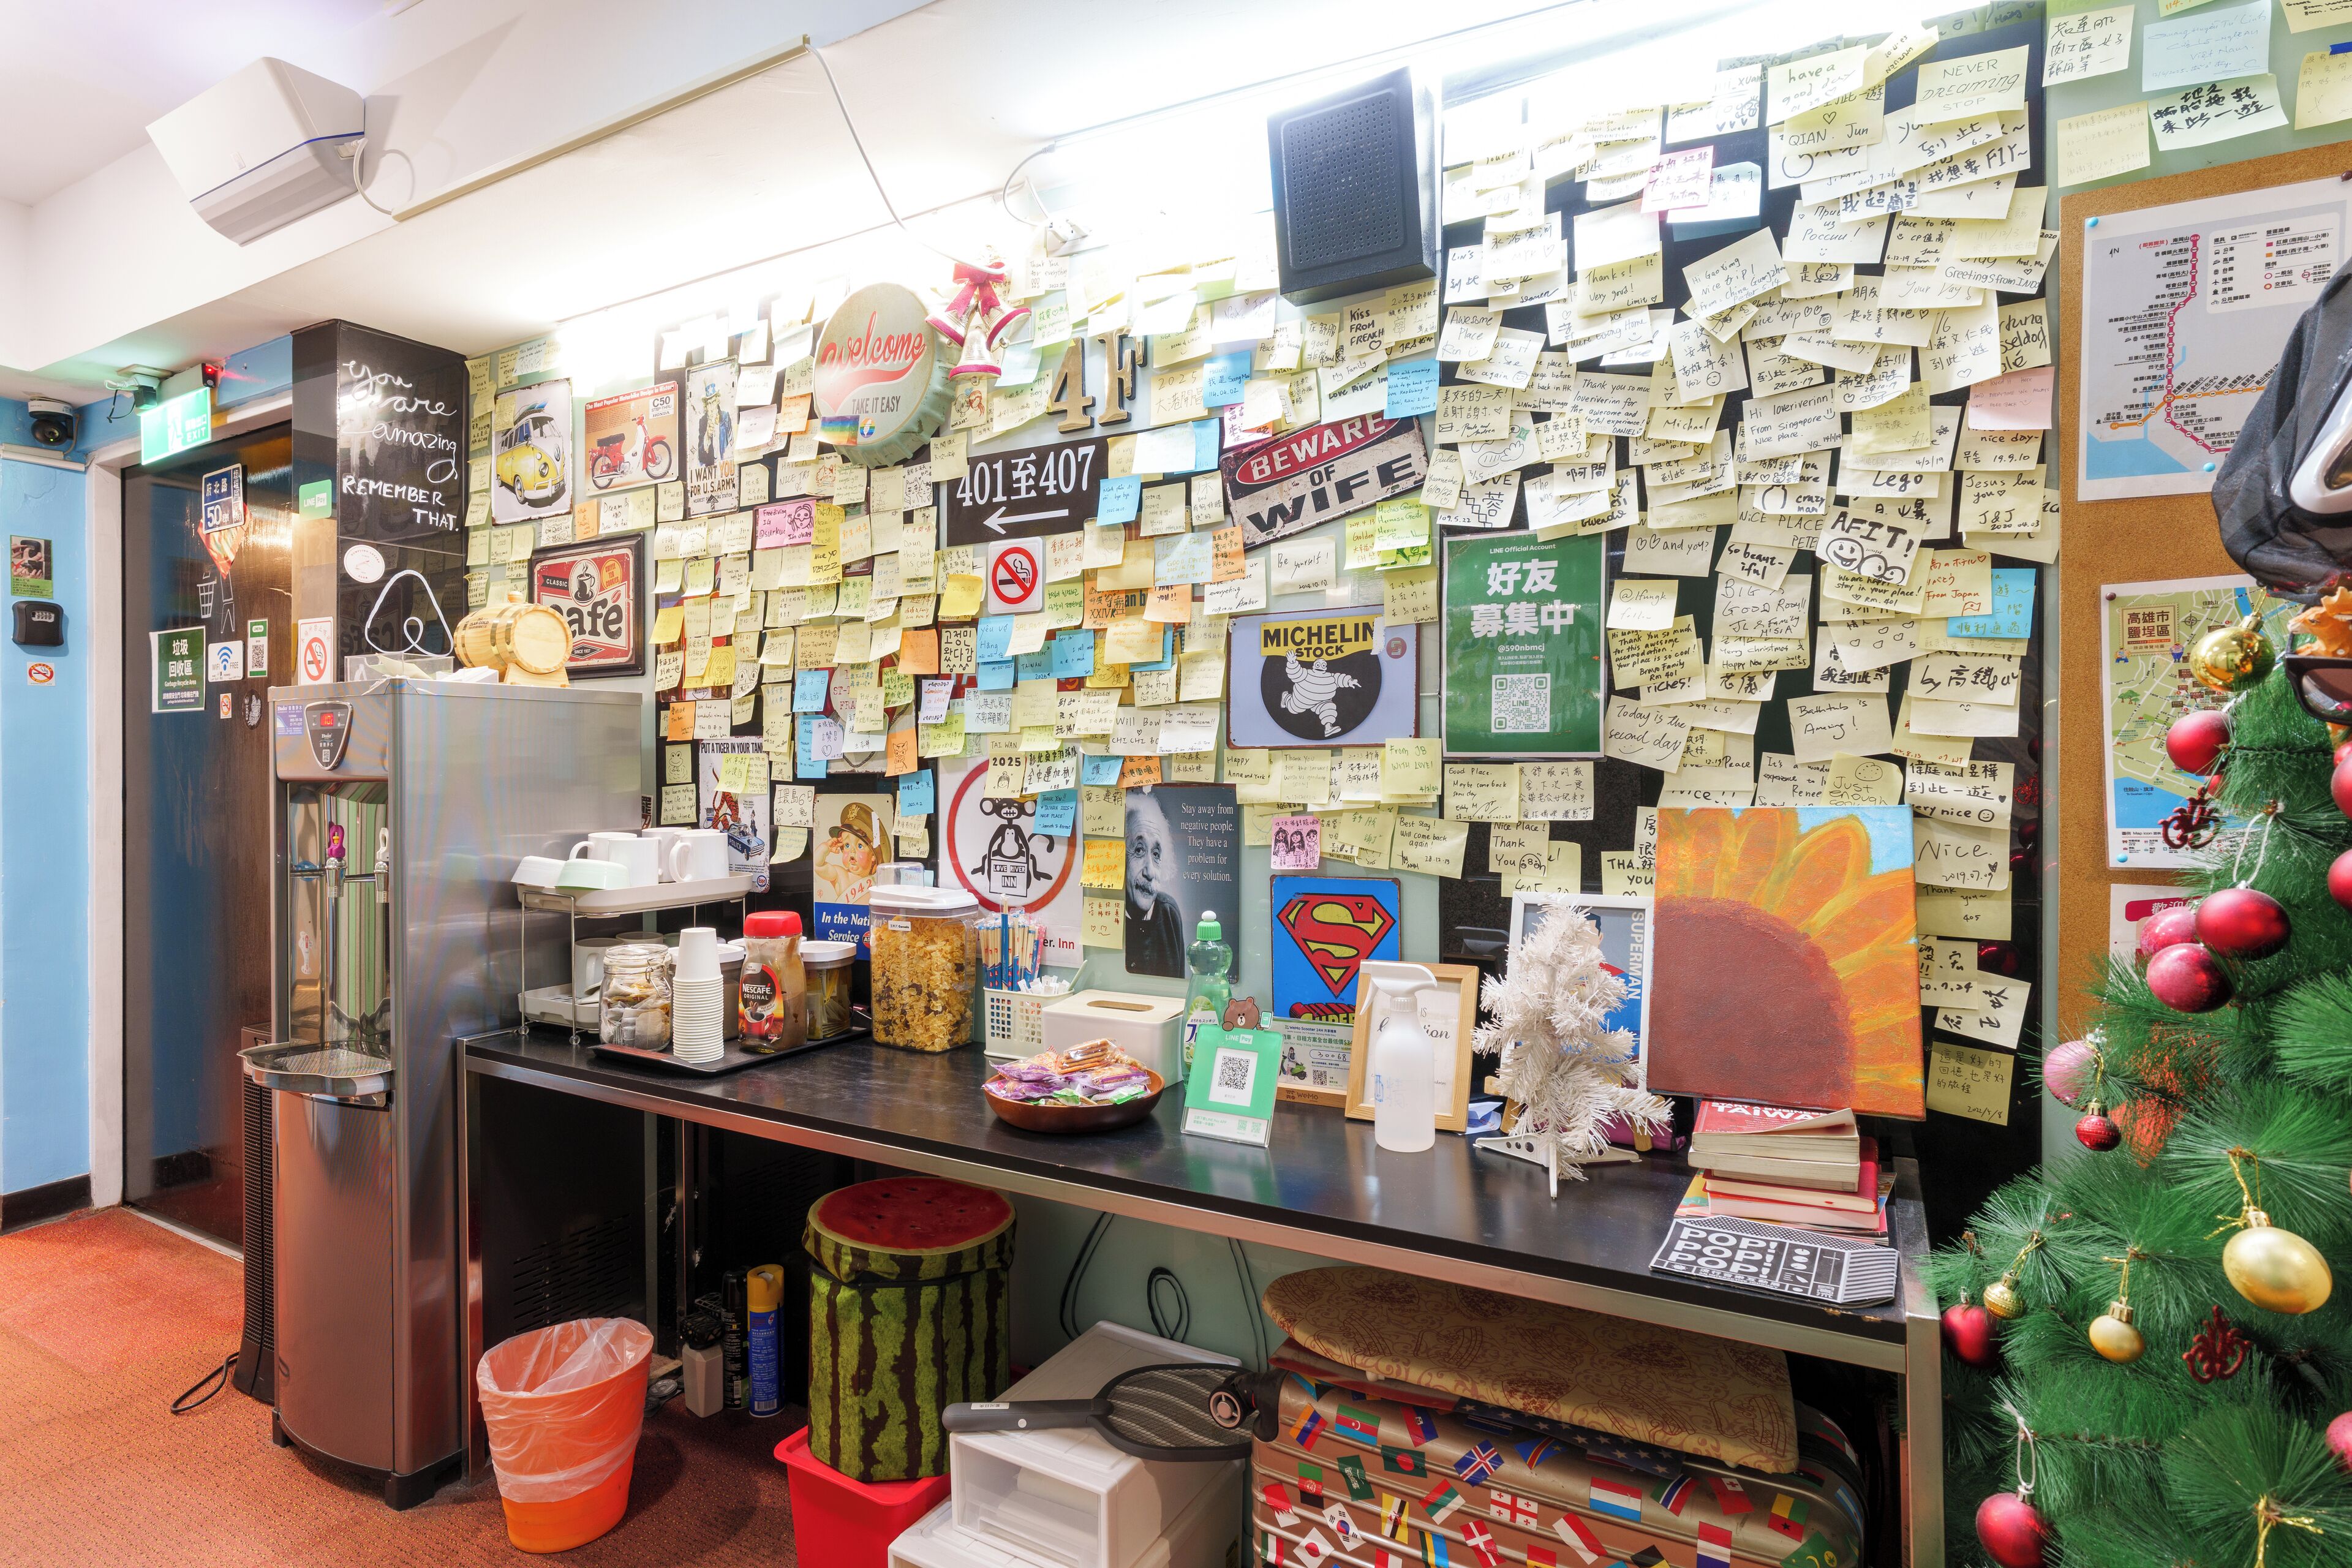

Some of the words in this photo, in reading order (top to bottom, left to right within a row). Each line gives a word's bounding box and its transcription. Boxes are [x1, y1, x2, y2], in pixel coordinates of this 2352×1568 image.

[1943, 59, 1999, 79] NEVER
[1943, 97, 1986, 111] STOP
[1350, 320, 1375, 334] FROM
[1458, 327, 1483, 341] Place
[821, 311, 927, 368] welcome
[1333, 372, 1344, 382] My
[1345, 360, 1366, 375] Family
[343, 361, 412, 401] you
[369, 397, 457, 415] are
[653, 396, 670, 407] C50
[852, 398, 870, 415] TAKE
[871, 396, 878, 414] IT
[881, 395, 901, 413] EASY
[187, 427, 206, 442] EXIT
[341, 423, 458, 483] amazing
[1251, 411, 1387, 481] BEWARE
[691, 470, 692, 483] I
[695, 466, 717, 482] WANT
[719, 460, 734, 478] YOU
[956, 444, 1096, 507] 401至407
[1310, 463, 1336, 486] OF
[206, 478, 228, 497] 府北路
[1872, 471, 1923, 492] Lego
[1966, 475, 2005, 489] Jesus
[2013, 473, 2038, 487] love
[342, 475, 445, 506] REMEMBER
[1246, 453, 1416, 533] WIFE
[1973, 490, 1994, 503] you
[207, 505, 222, 527] 50
[763, 508, 787, 518] Freediving
[605, 563, 616, 573] COFFEE
[546, 578, 568, 587] CLASSIC
[1487, 558, 1558, 597] 好友
[1926, 590, 1947, 601] From
[1952, 589, 1980, 603] Japan
[1471, 599, 1575, 638] 募集中
[2127, 610, 2170, 625] 高雄市
[1263, 620, 1376, 648] MICHELIN
[2127, 624, 2171, 639] 鹽埕區
[173, 639, 188, 655] 垃圾
[1295, 644, 1344, 658] STOCK
[1498, 644, 1545, 653] @590nbmcj
[169, 660, 192, 677] 回收區
[1640, 665, 1660, 676] Bravo
[1662, 660, 1685, 671] Family
[1722, 660, 1745, 669] Happy
[1749, 658, 1762, 668] New
[701, 742, 710, 753] PUT
[711, 742, 715, 753] A
[715, 742, 729, 753] TIGER
[731, 742, 735, 753] IN
[736, 742, 750, 753] YOUR
[1608, 731, 1650, 744] second
[1653, 734, 1681, 761] day
[992, 756, 1022, 767] 2025
[1227, 756, 1250, 765] Happy
[1722, 755, 1751, 769] Peace
[1182, 803, 1196, 816] Stay
[1197, 806, 1216, 817] away
[1217, 804, 1234, 815] from
[1180, 820, 1208, 832] negative
[1210, 821, 1234, 834] people.
[1399, 817, 1417, 829] Best
[729, 837, 742, 851] POLICE
[1188, 836, 1205, 850] They
[1206, 837, 1221, 848] have
[1493, 836, 1525, 848] Thank
[1188, 854, 1215, 865] problem
[1217, 854, 1227, 864] for
[1496, 854, 1516, 867] You
[993, 864, 1008, 873] LOVE
[1010, 864, 1025, 874] RIVER
[1183, 871, 1202, 883] every
[1203, 870, 1232, 882] solution.
[1001, 875, 1017, 888] INN
[844, 880, 872, 904] 1942
[821, 911, 832, 923] In
[836, 913, 848, 924] the
[851, 913, 870, 925] Nati
[827, 929, 859, 943] Service
[1058, 937, 1075, 950] Inn
[1627, 911, 1643, 1000] SUPERMAN
[1318, 1052, 1346, 1061] 30068
[1711, 1105, 1815, 1120] TAIWA
[1679, 1226, 1777, 1253] POP!
[1674, 1240, 1774, 1267] POP!
[1667, 1251, 1770, 1279] POP!
